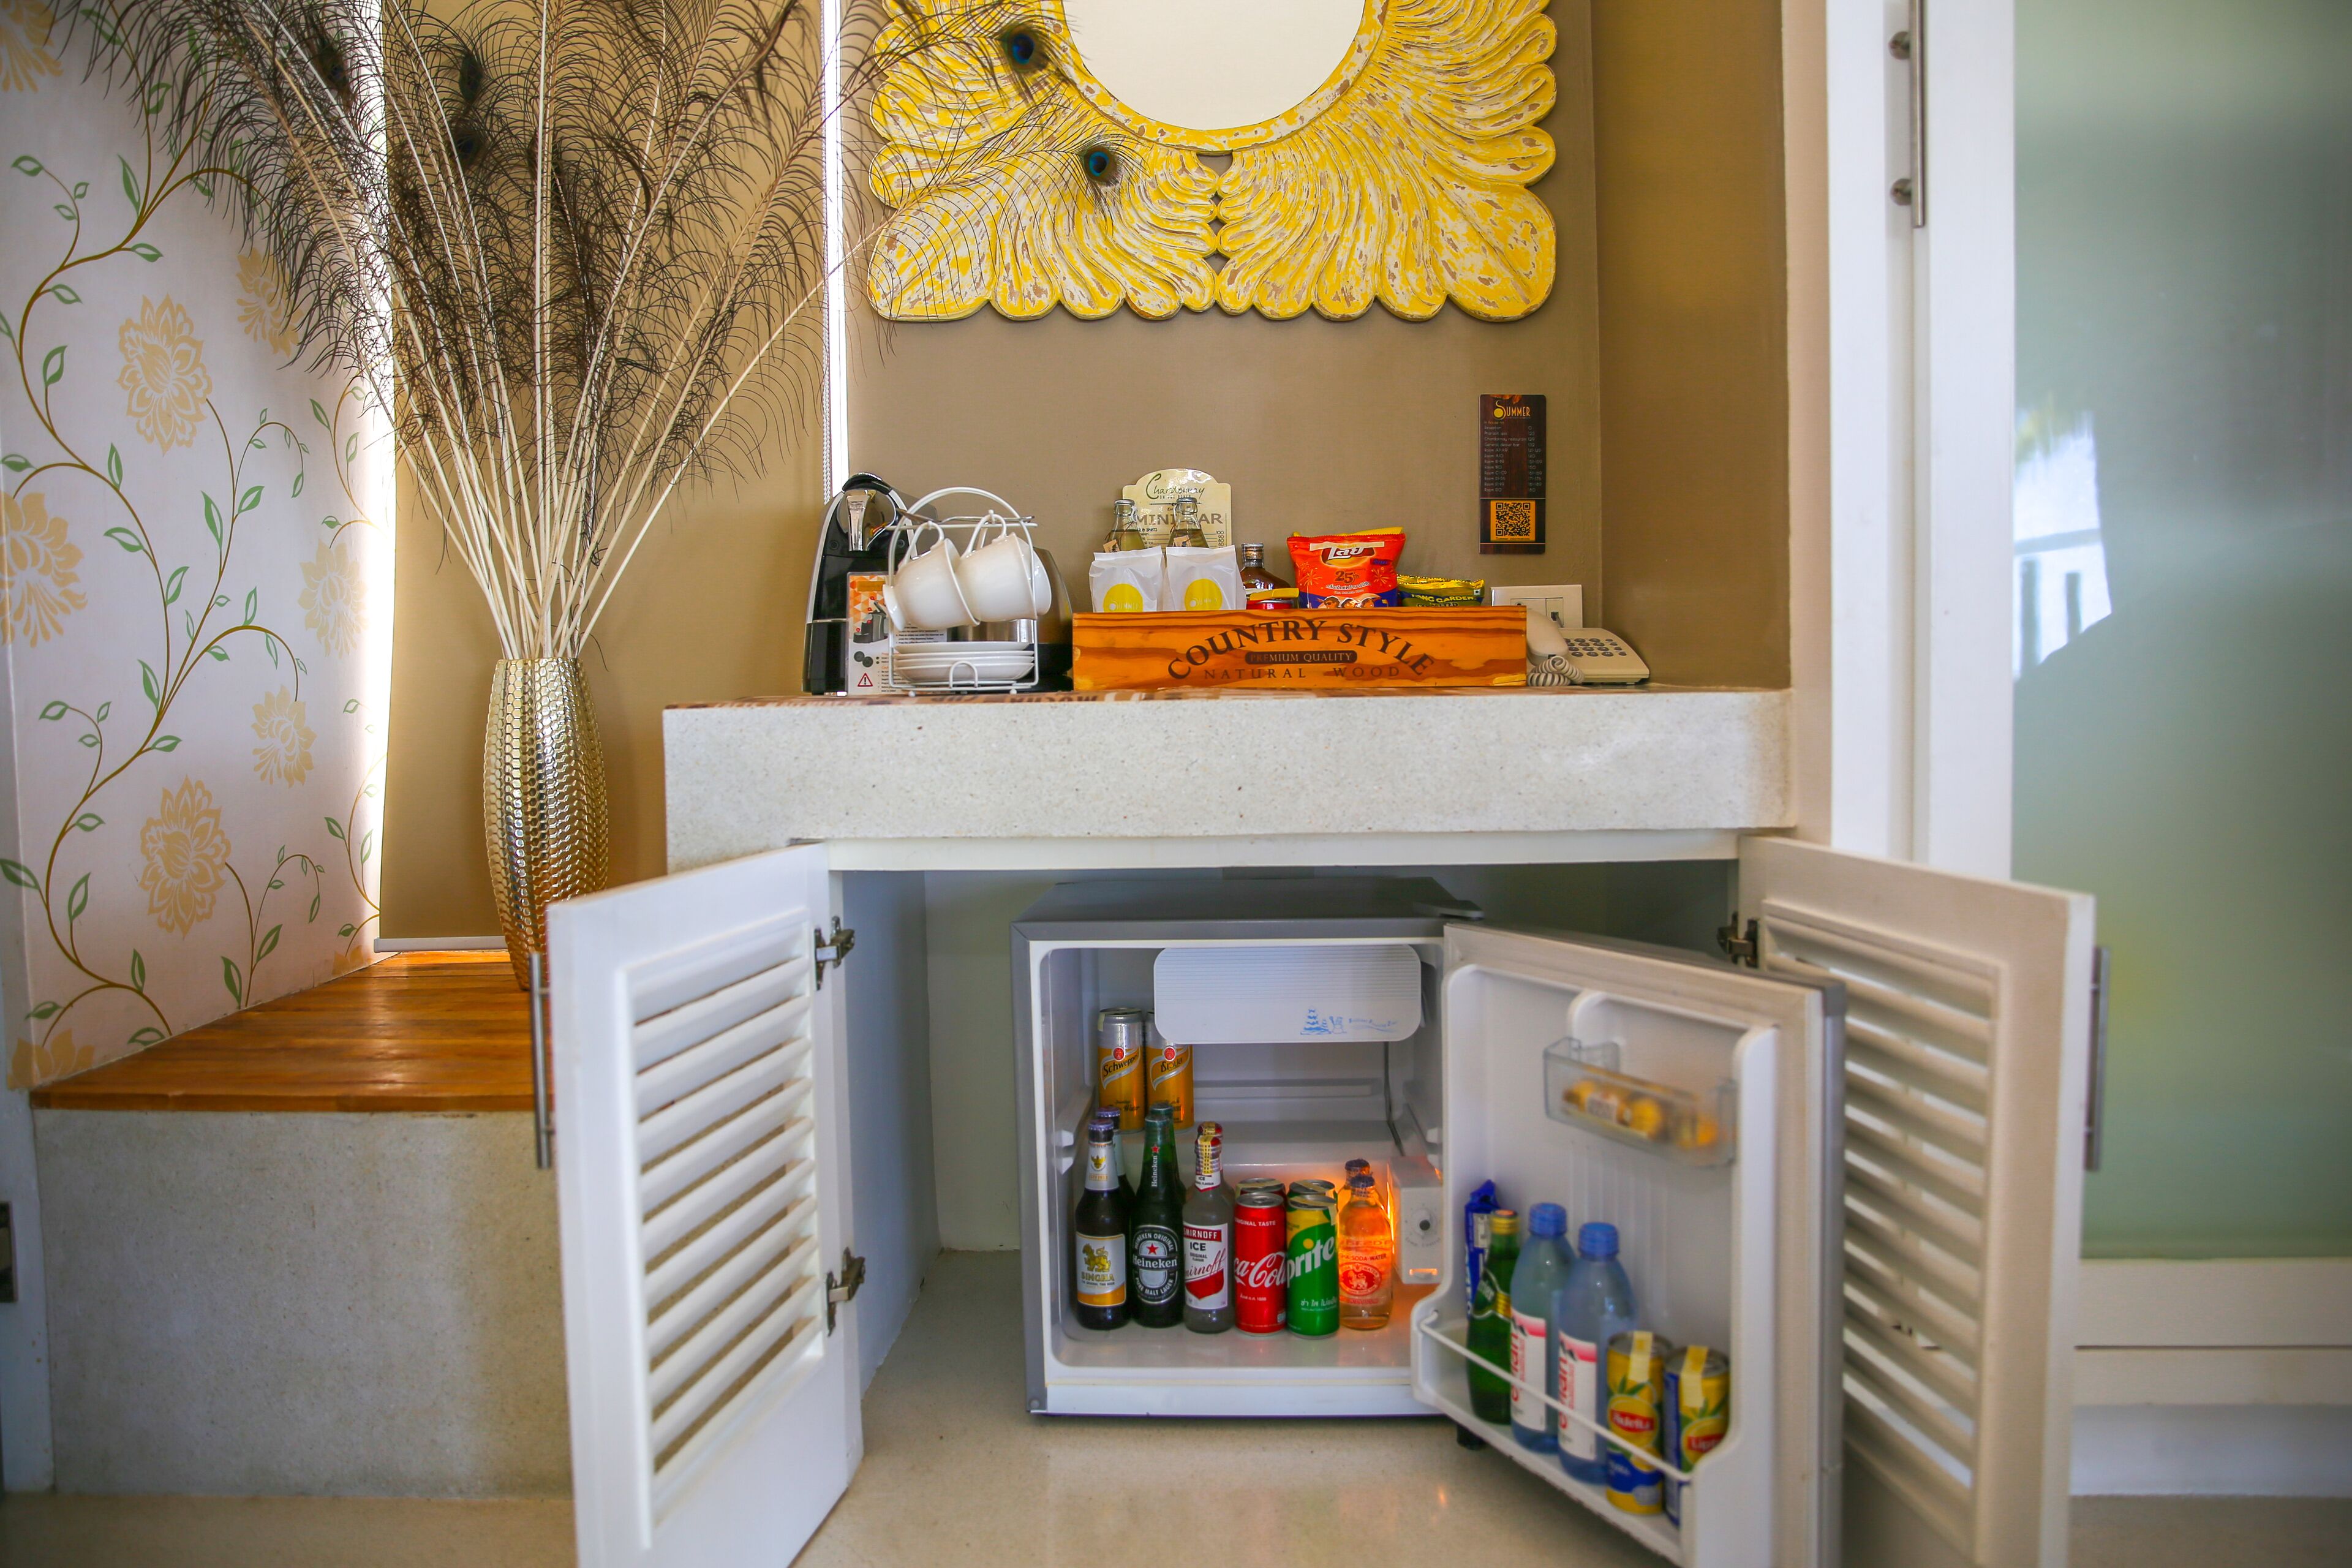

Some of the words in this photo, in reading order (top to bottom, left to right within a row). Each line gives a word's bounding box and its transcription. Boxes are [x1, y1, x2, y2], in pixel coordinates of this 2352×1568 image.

[1494, 400, 1530, 420] SUMMER
[1145, 473, 1205, 500] Chardonnay
[1198, 513, 1224, 524] AR
[1167, 619, 1327, 680] COUNTRY
[1336, 623, 1434, 676] STYLE
[1250, 653, 1298, 663] PREMIUM
[1303, 652, 1352, 662] QUALITY
[1204, 668, 1306, 680] NATURAL
[1333, 666, 1400, 677] WOOD
[1153, 1232, 1174, 1251] ORIGINAL
[1190, 1241, 1207, 1251] ICE
[1133, 1254, 1178, 1269] Heineken
[1287, 1236, 1335, 1289] prite
[1081, 1272, 1115, 1282] SINGHA
[1160, 1278, 1174, 1294] LAGER
[1510, 1332, 1519, 1402] eian
